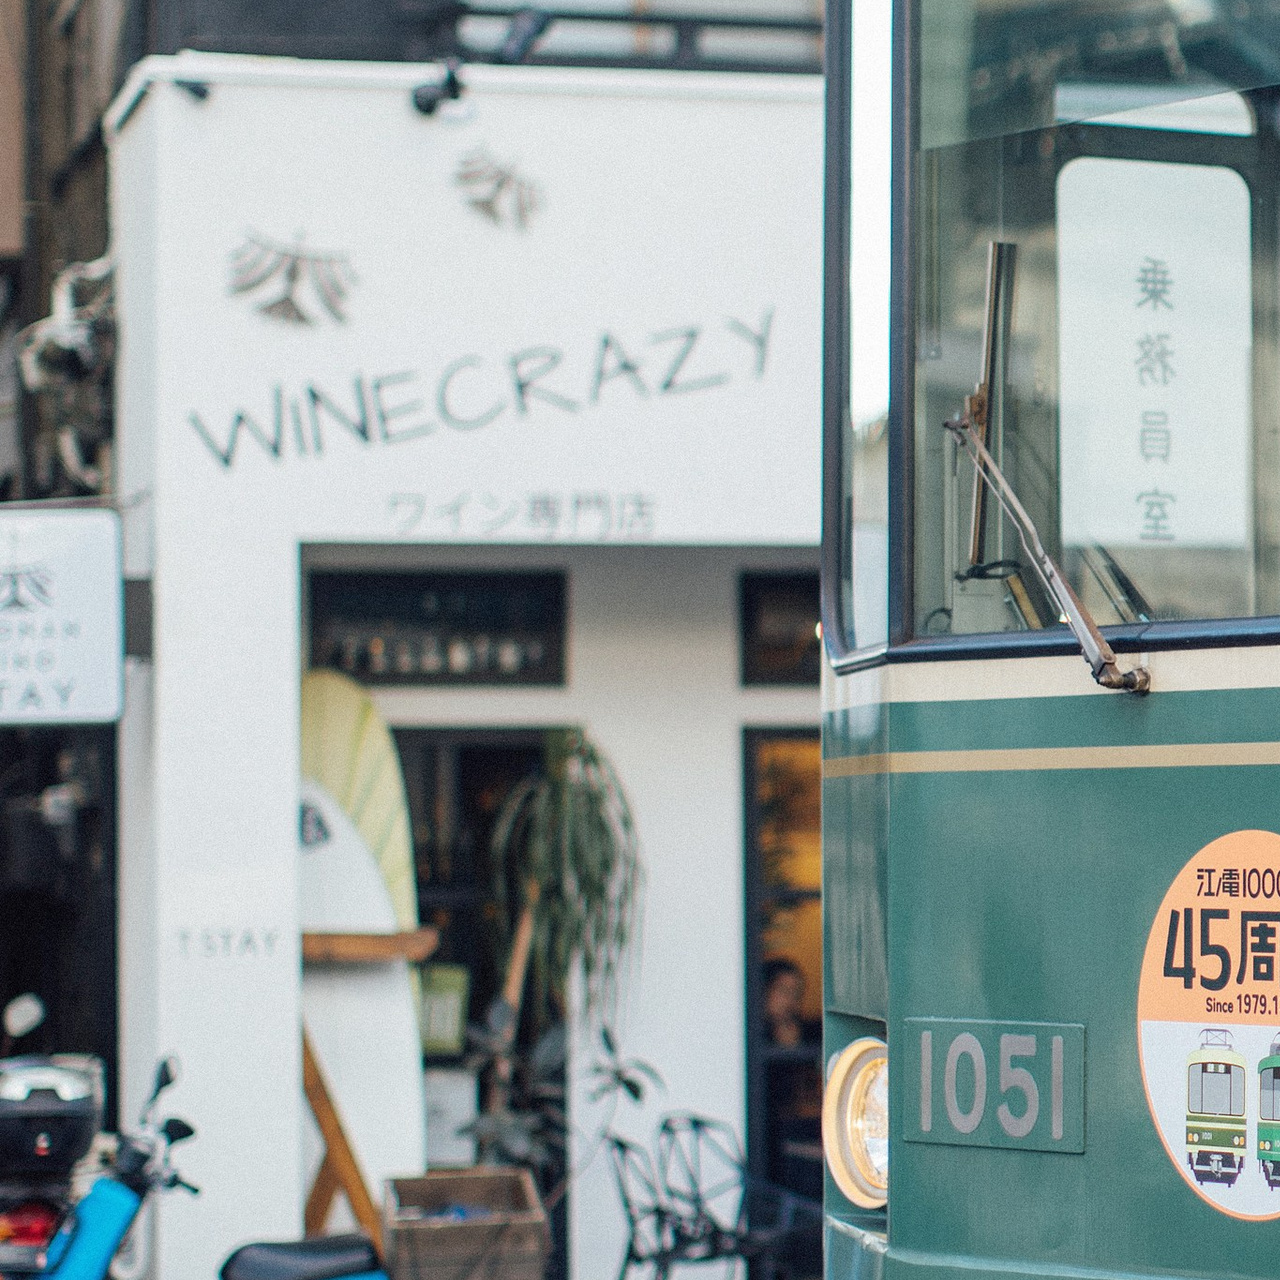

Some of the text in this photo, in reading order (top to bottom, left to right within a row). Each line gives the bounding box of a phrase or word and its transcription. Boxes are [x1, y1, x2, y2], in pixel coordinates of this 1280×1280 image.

[187, 305, 775, 470] WINECRAZY
[1206, 996, 1234, 1013] Since
[920, 1030, 1064, 1140] 1051
